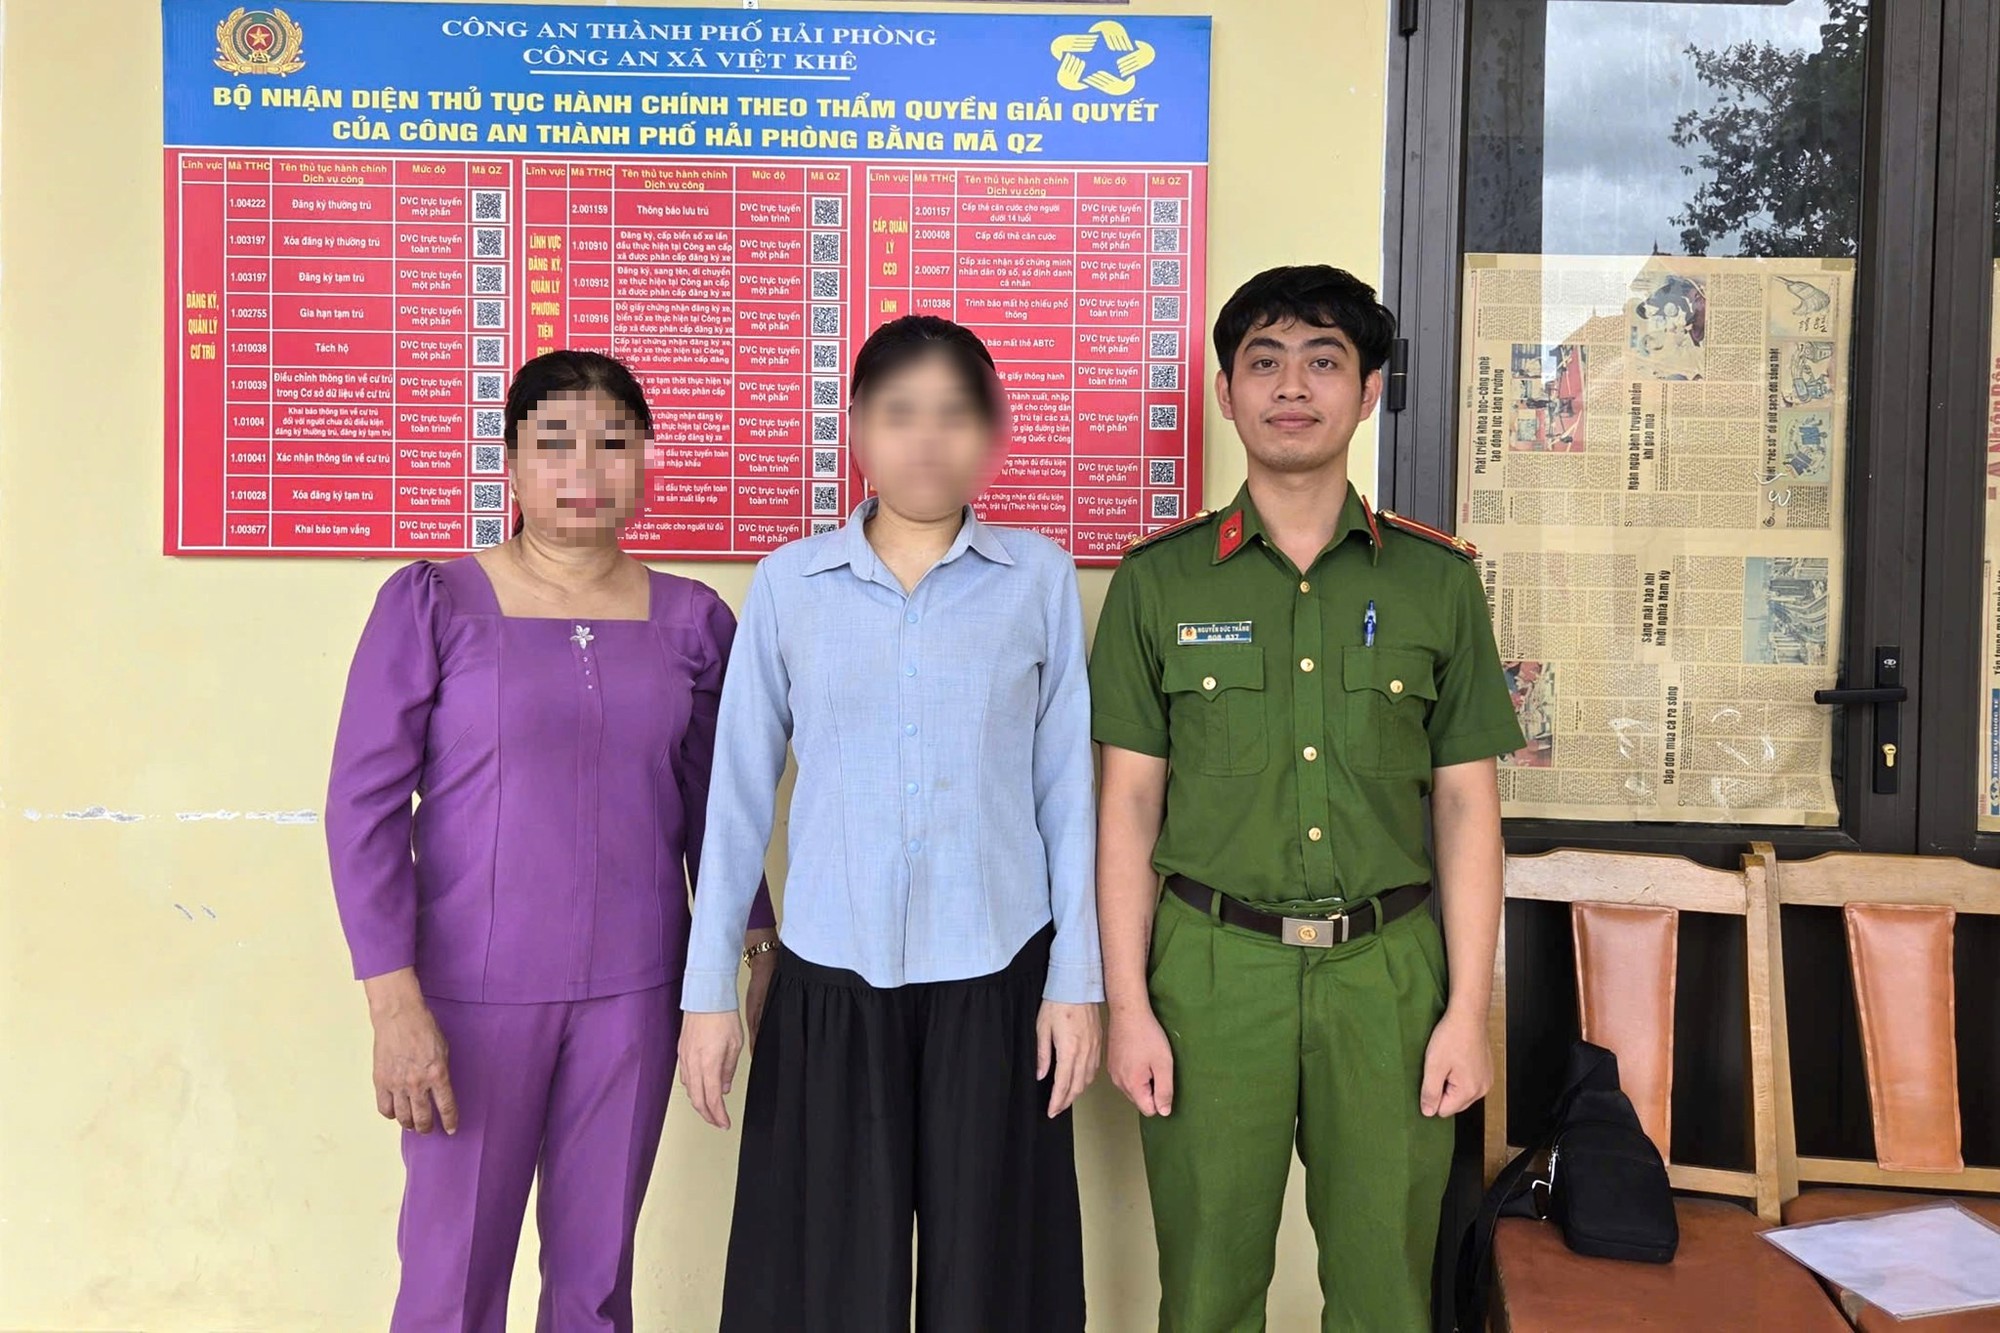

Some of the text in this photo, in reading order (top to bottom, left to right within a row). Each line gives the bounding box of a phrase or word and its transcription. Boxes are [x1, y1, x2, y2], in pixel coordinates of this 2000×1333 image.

[442, 16, 937, 46] CÔNG AN THÀNH PHỐ HẢI PHÒNG
[523, 44, 858, 73] CÔNG AN XÃ VIỆT KHÊ
[213, 83, 1160, 124] BỘ NHẬN DIỆN THỦ TỤC HÀNH CHÍNH THEO THẨM QUYỀN GIẢI QUYẾT
[332, 115, 1043, 154] CỦA CÔNG AN THÀNH PHỐ HẢI PHÒNG BẰNG MÃ QZ
[182, 160, 223, 171] Lĩnh vực
[228, 160, 271, 171] Mã TTHC
[279, 162, 387, 176] Tên thủ tục hành chính
[412, 164, 447, 175] Mức độ
[472, 165, 502, 175] Mã QZ
[302, 173, 364, 185] Dịch vụ công
[229, 198, 266, 208] 1.004222
[292, 199, 372, 212] Đăng ký thường trú
[571, 204, 608, 214] 2.001159
[636, 204, 709, 217] Thông báo lưu trú
[915, 206, 951, 216] 2.001157
[229, 235, 266, 245] 1.003197
[915, 229, 951, 240] 2.000408
[975, 230, 1057, 241] Cấp đổi thẻ căn cước
[283, 236, 380, 249] Xóa đăng ký thường trú
[572, 240, 608, 251] 1.010910
[914, 265, 951, 275] 2.000677
[230, 272, 267, 282] 1.003197
[298, 272, 365, 284] Đăng ký tạm trú
[573, 277, 609, 288] 1.010912
[916, 298, 951, 308] 1.010386
[231, 308, 268, 318] 1.002755
[299, 308, 364, 319] Gia hạn tạm trú
[573, 313, 609, 324] 1.010916
[231, 343, 268, 353] 1.010038
[315, 342, 349, 354] Tách hộ
[231, 380, 268, 390] 1.010039
[233, 416, 265, 427] 1.01004
[231, 453, 266, 463] 1.010041
[230, 490, 267, 500] 1.010028
[230, 524, 267, 534] 1.003677
